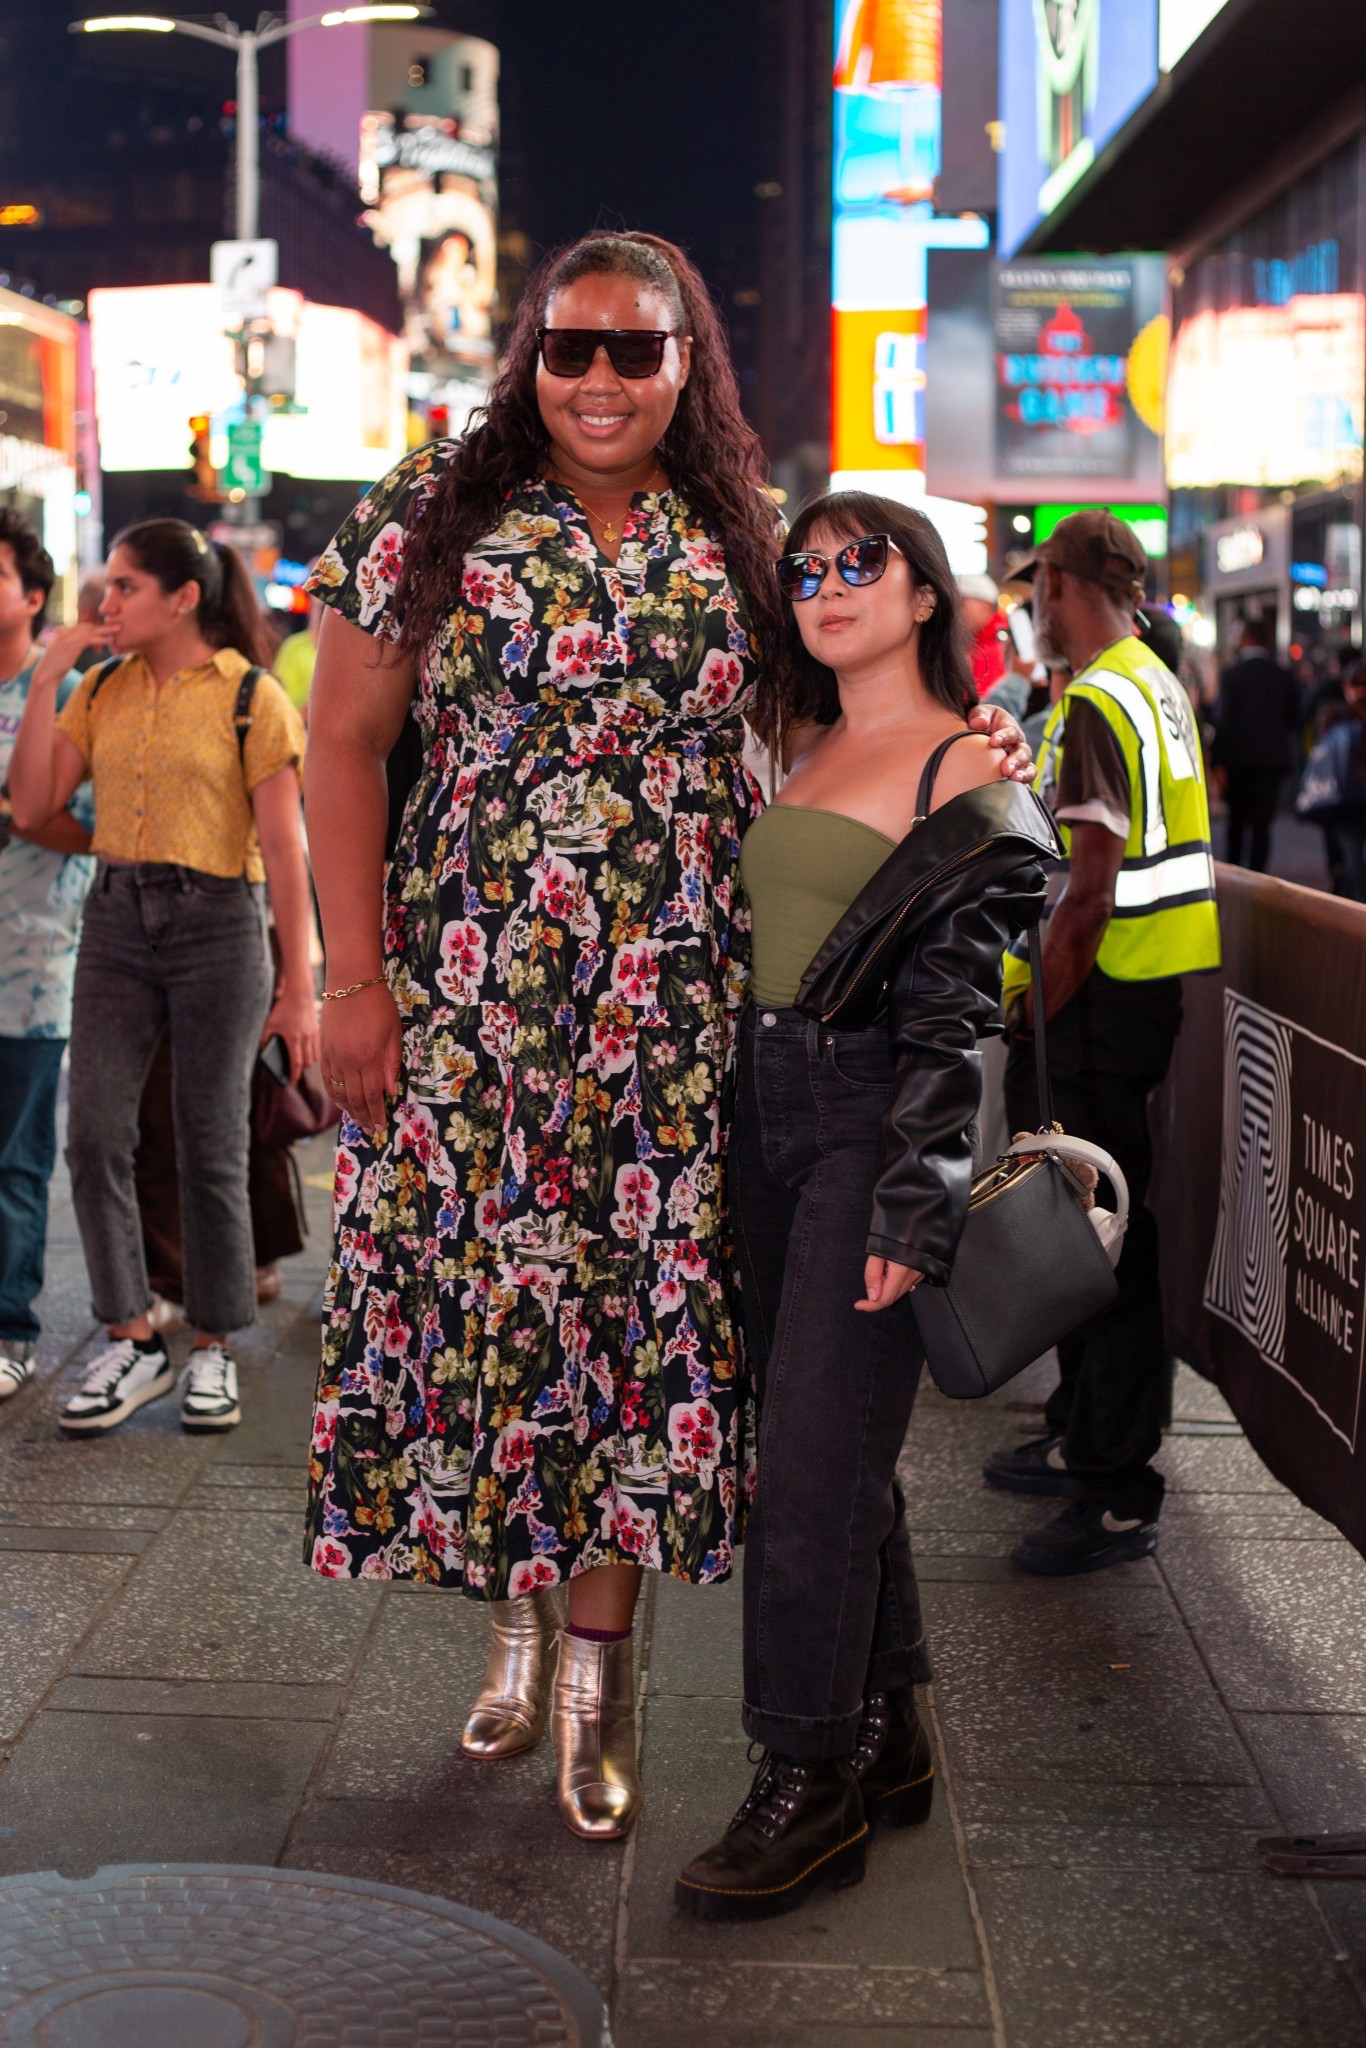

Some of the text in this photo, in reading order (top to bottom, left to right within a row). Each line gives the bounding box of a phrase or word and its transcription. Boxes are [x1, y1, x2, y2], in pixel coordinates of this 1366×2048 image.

[1303, 1113, 1354, 1200] TIMES
[1294, 1186, 1360, 1289] SQUARE
[1295, 1268, 1354, 1354] ALLIANCE
